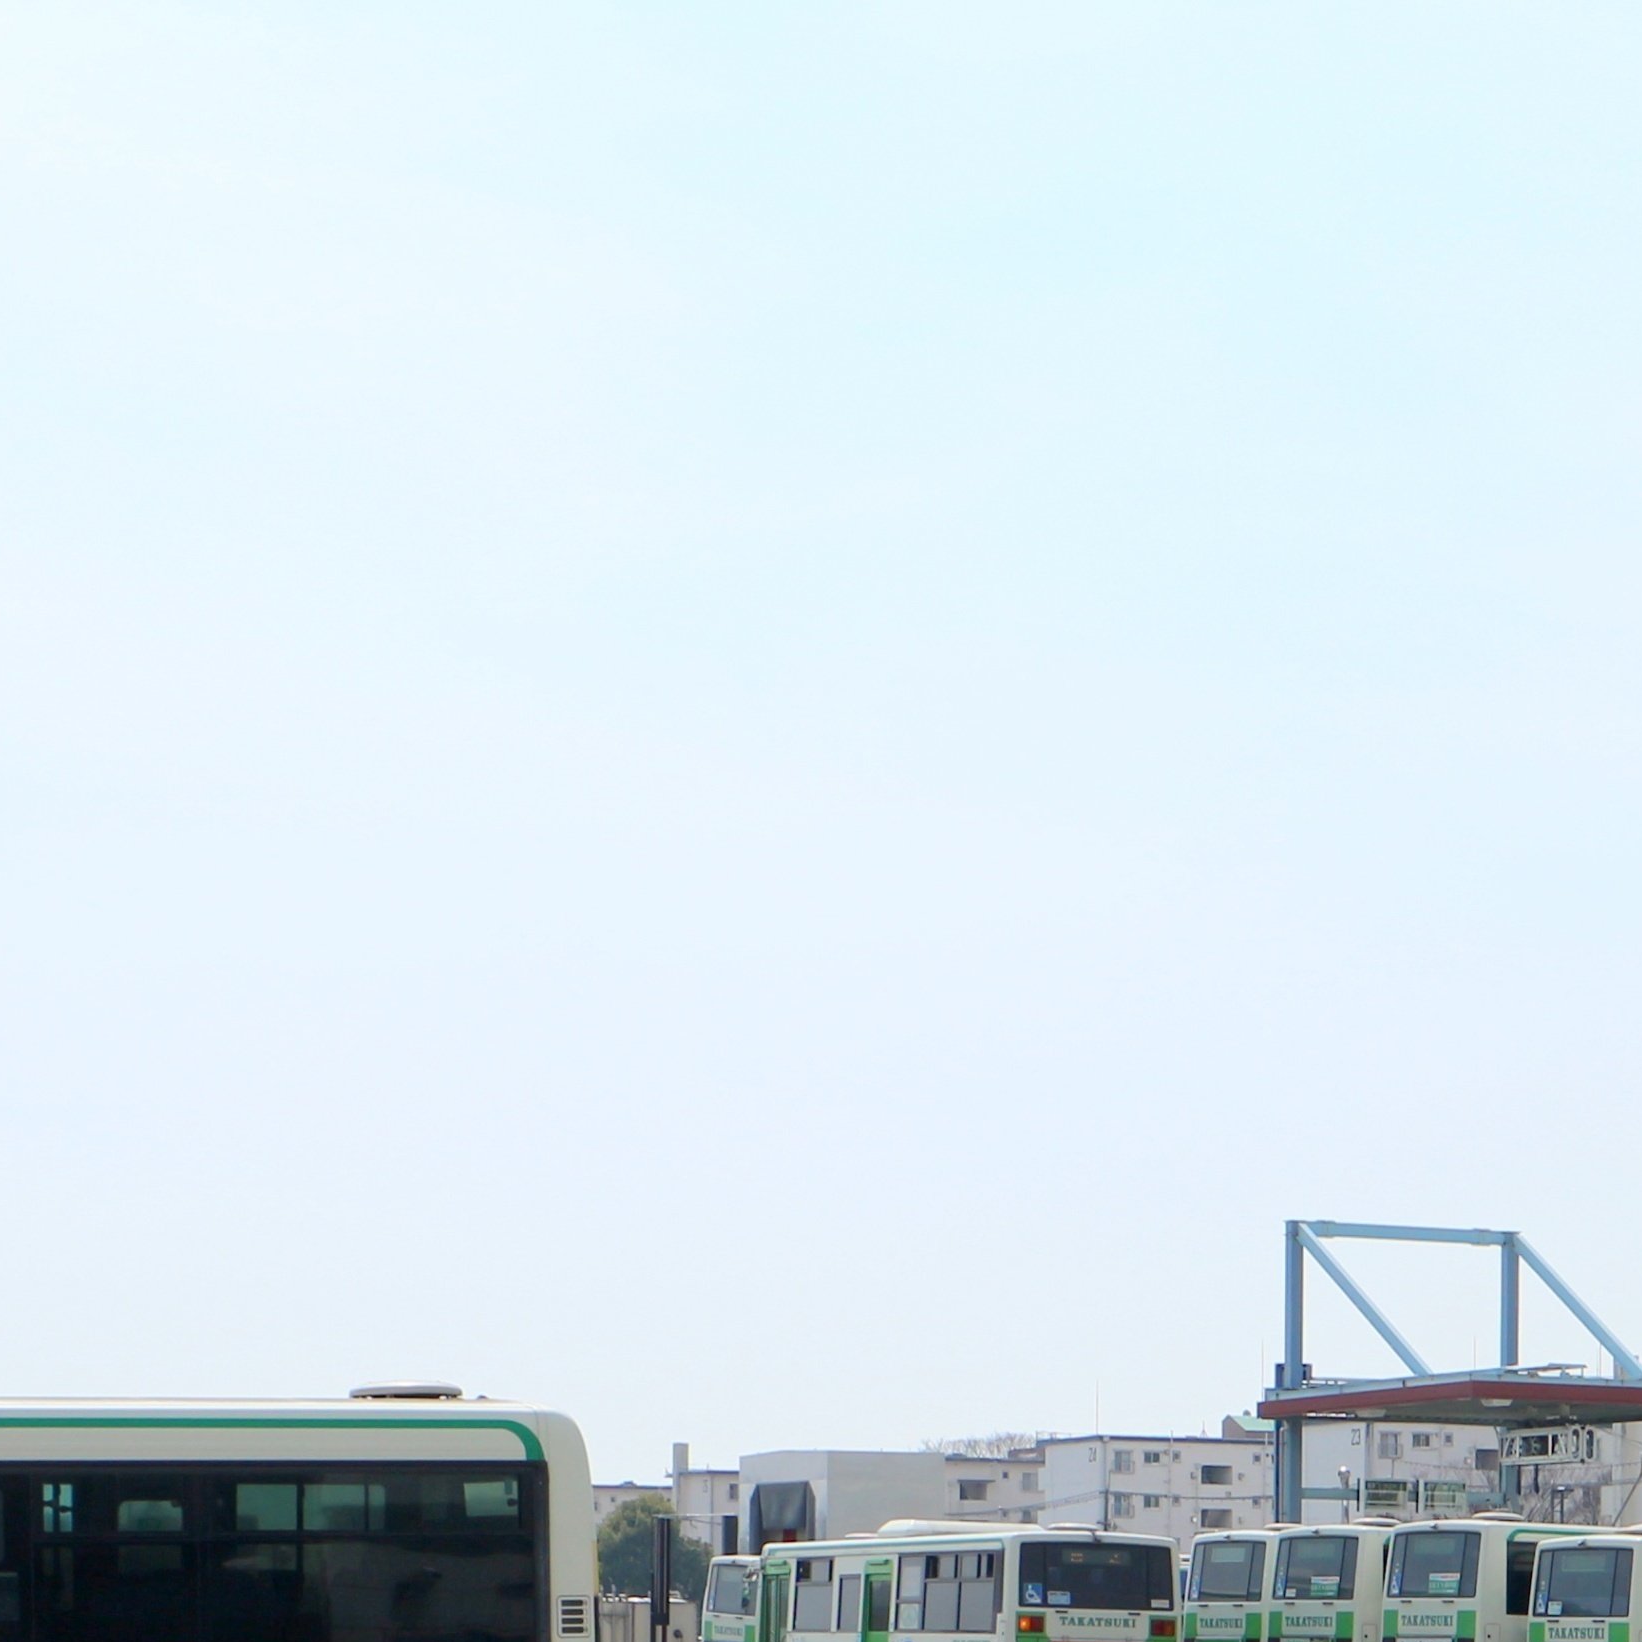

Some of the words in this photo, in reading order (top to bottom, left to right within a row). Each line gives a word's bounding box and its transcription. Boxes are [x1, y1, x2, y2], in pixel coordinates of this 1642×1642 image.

[1059, 1616, 1136, 1629] TAKATSUKI
[1200, 1618, 1243, 1629] TAKATSUKI
[1285, 1616, 1333, 1628] TAKATSUKI
[1401, 1615, 1453, 1627] TAKATSUKI
[1548, 1627, 1605, 1640] TAKATSUKI
